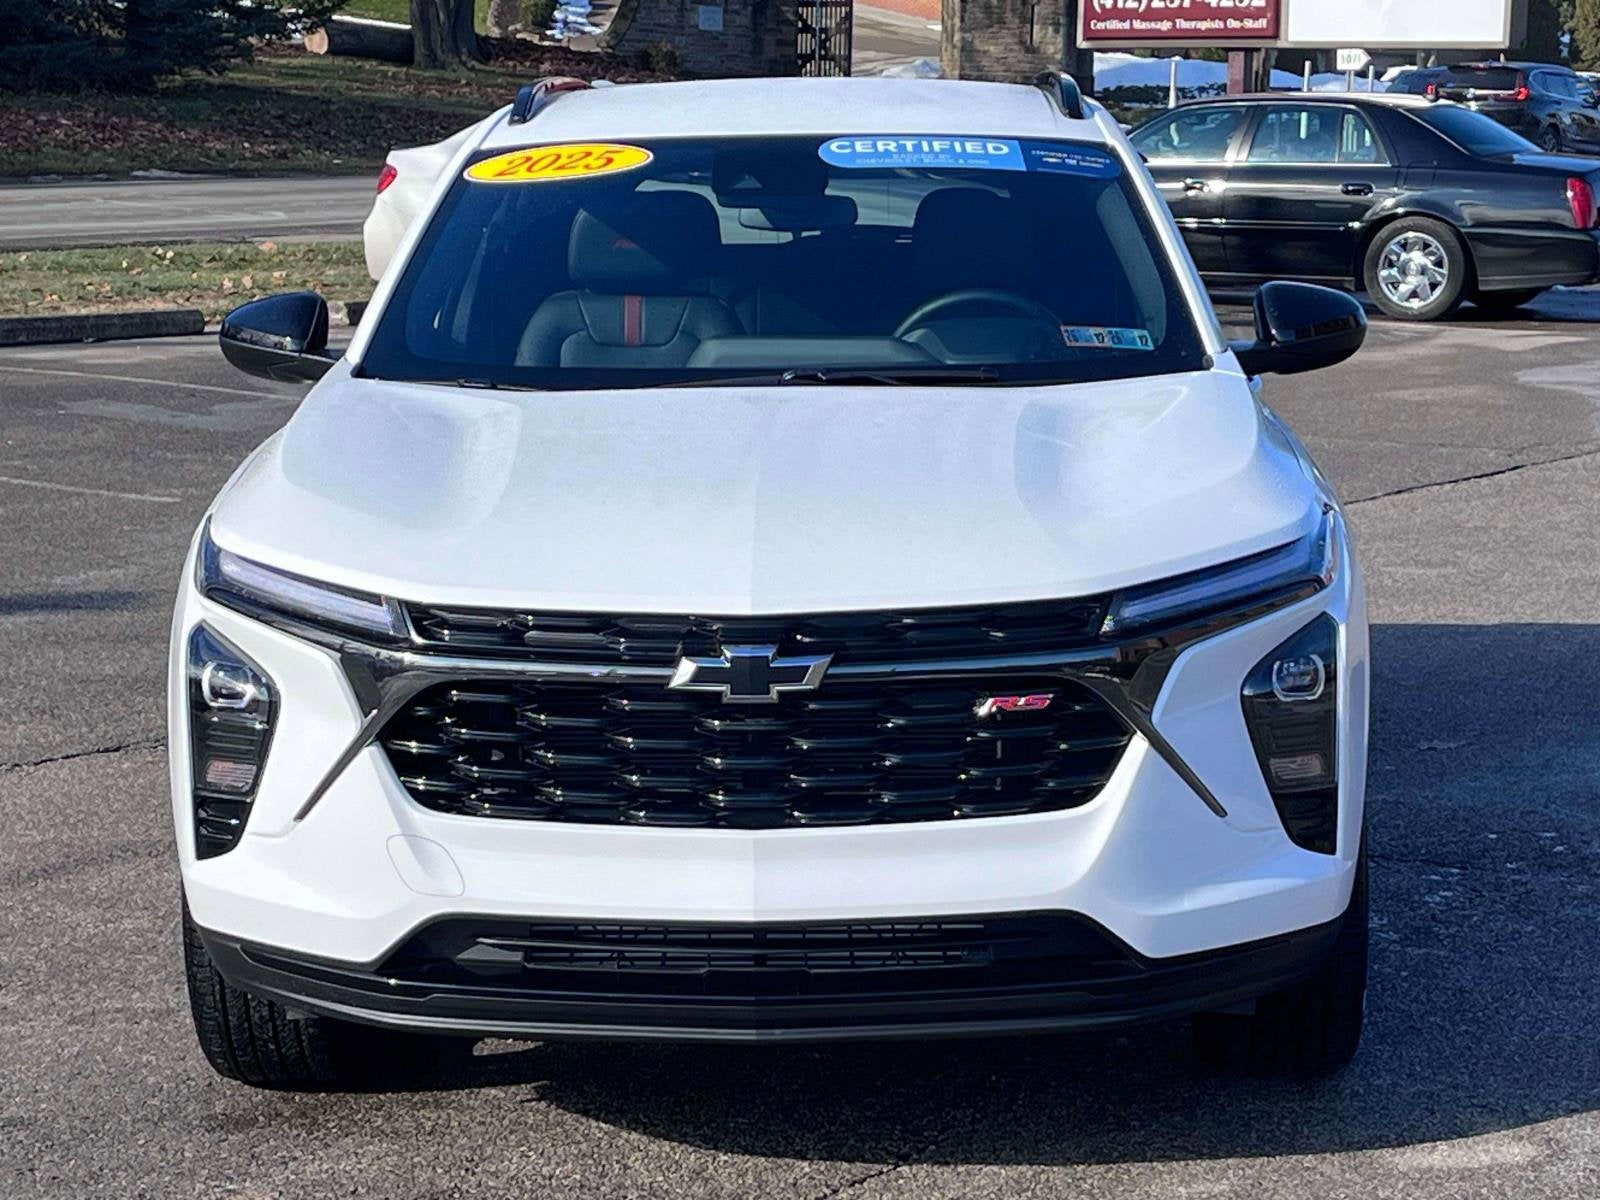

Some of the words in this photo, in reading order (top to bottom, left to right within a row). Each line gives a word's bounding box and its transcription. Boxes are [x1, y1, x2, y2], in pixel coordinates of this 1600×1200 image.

[1090, 18, 1131, 30] Certified
[1132, 18, 1173, 31] Massage
[1174, 17, 1225, 31] Therapists
[1226, 17, 1267, 29] On-Staff
[830, 140, 1010, 155] CERTIFIED
[493, 150, 624, 178] 2025
[977, 693, 1055, 717] RS
